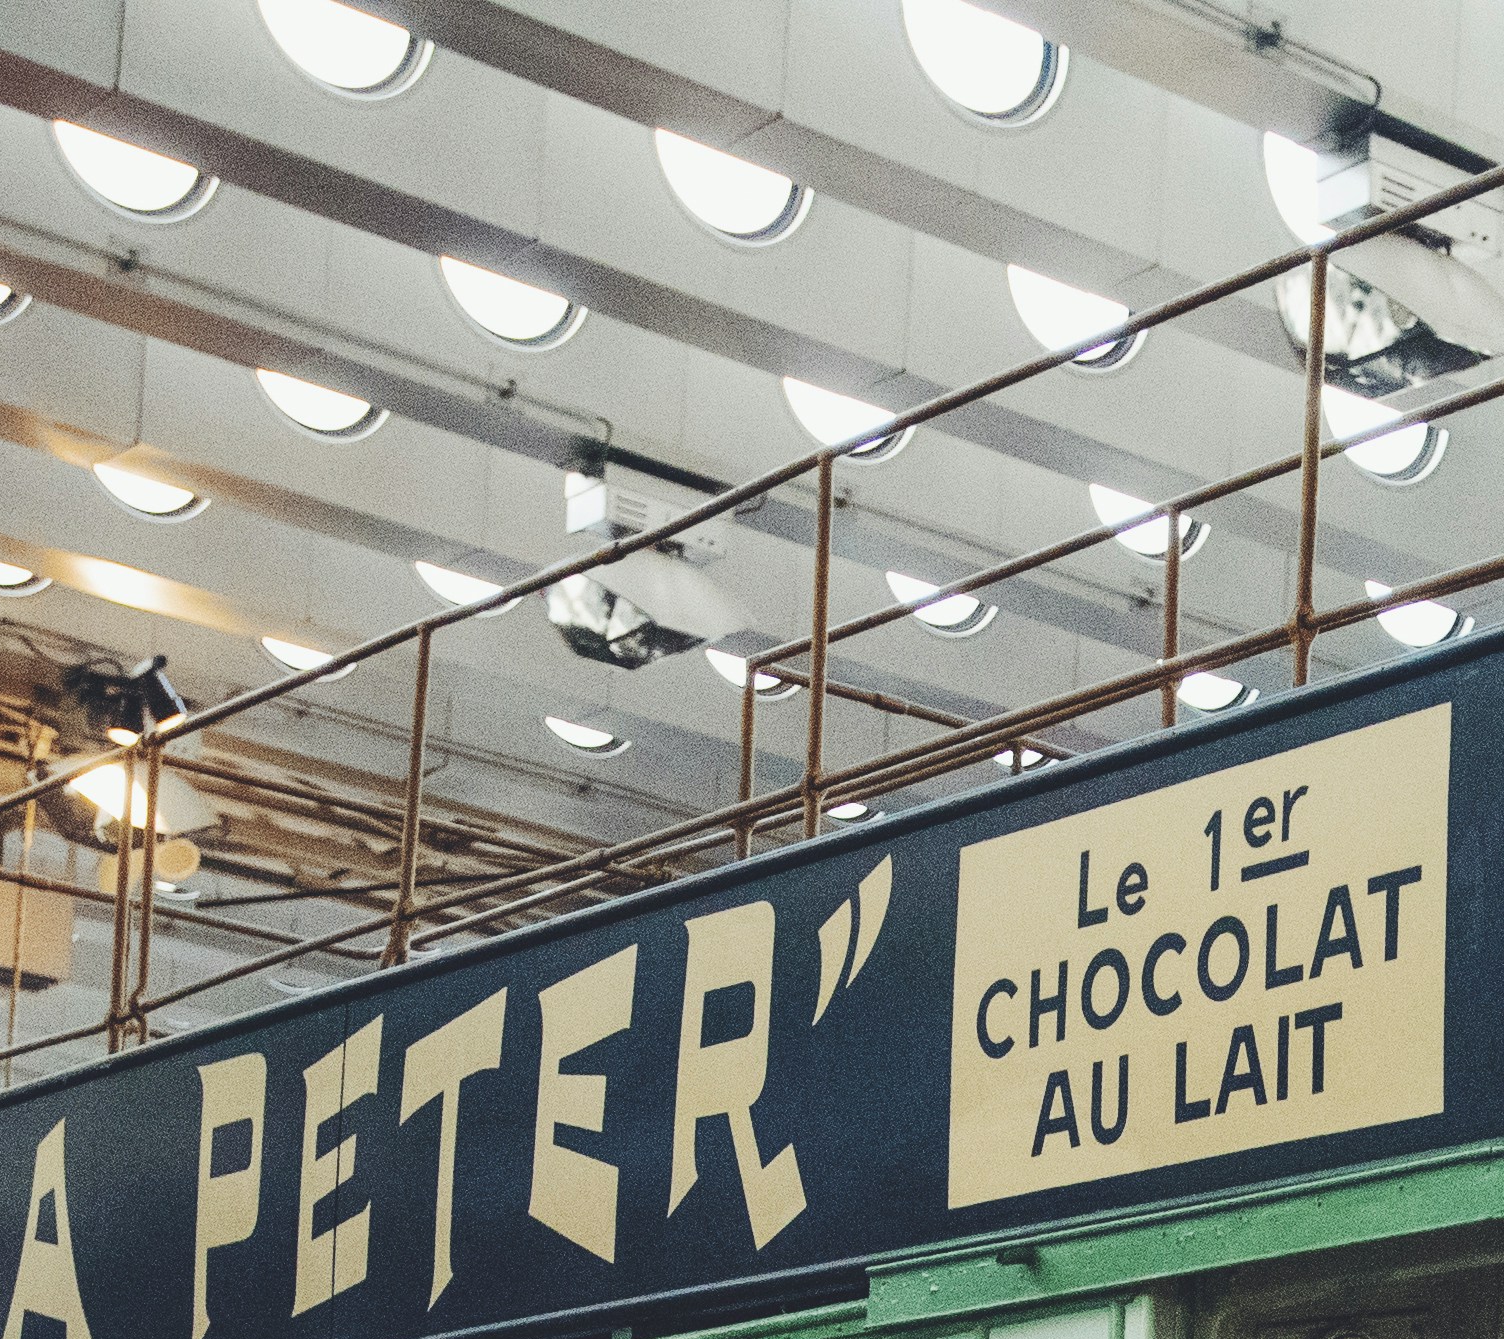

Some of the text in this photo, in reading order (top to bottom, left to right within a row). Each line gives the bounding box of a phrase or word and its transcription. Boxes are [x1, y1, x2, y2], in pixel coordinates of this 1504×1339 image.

[1077, 783, 1310, 929] Le 1er
[976, 863, 1423, 1060] CHOCOLAT
[1030, 1001, 1344, 1158] AU LAIT
